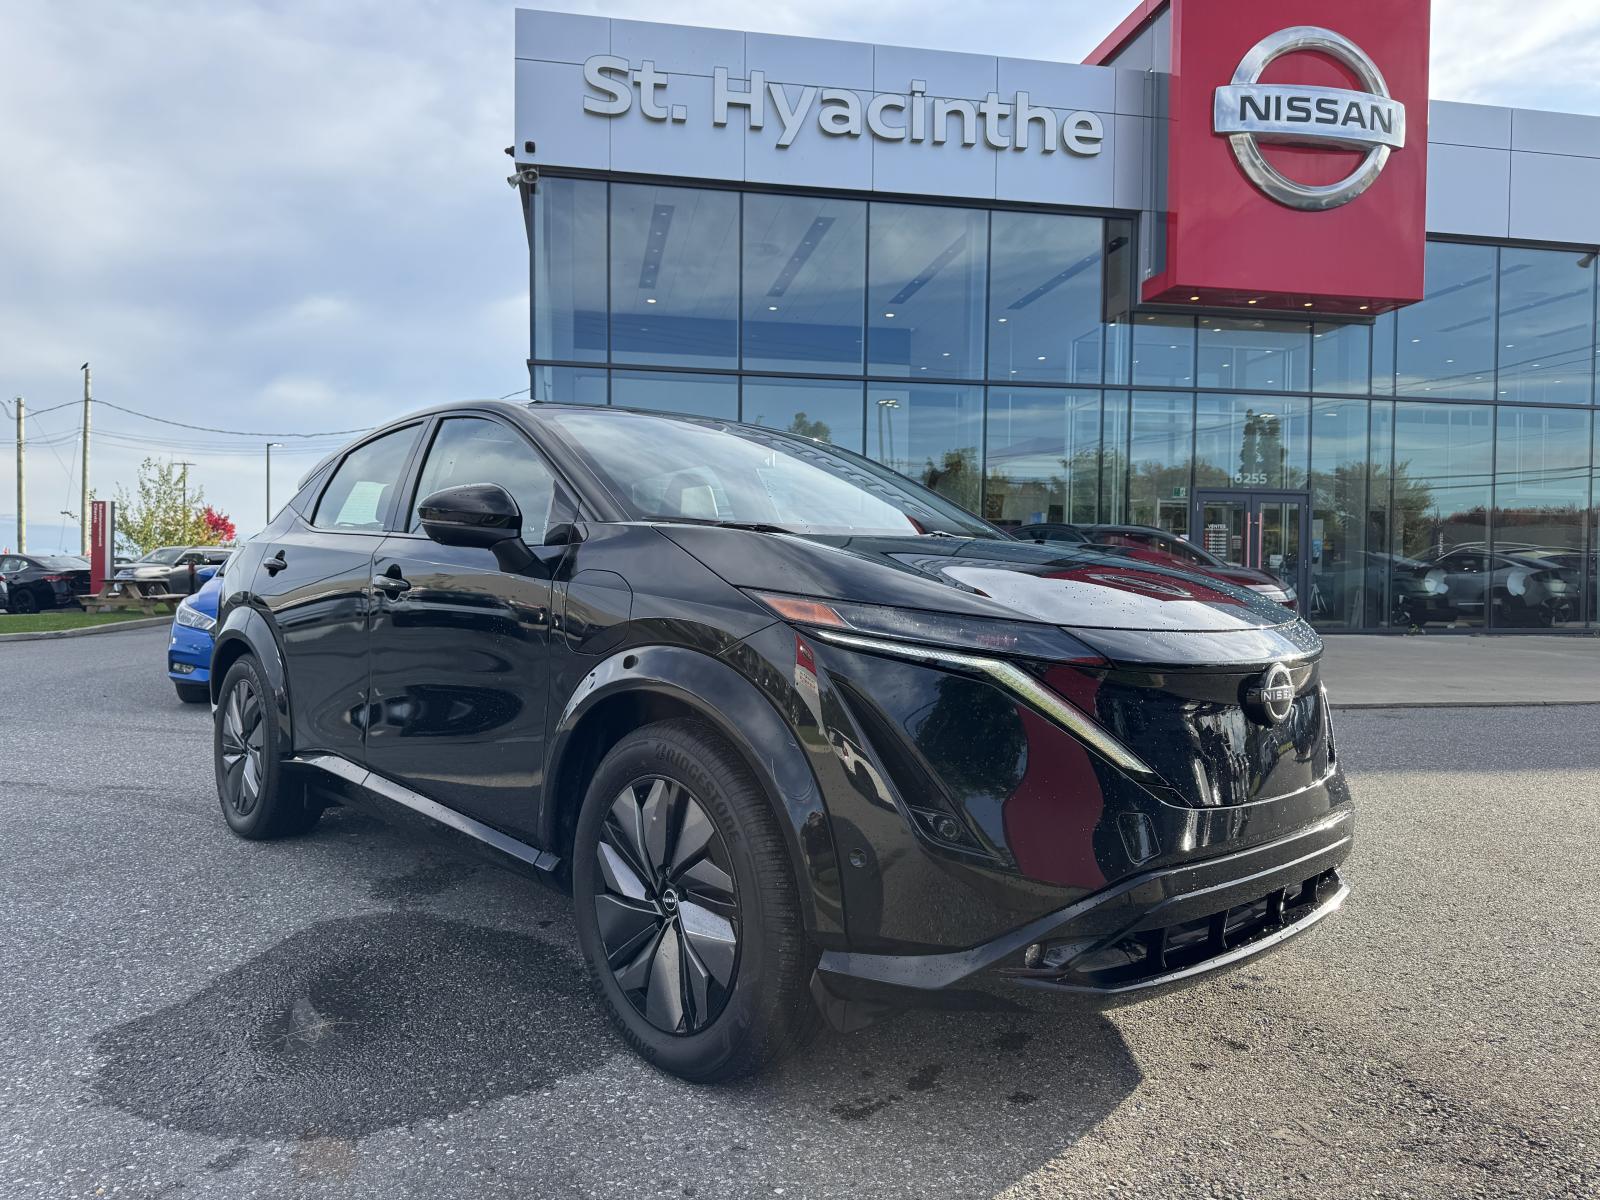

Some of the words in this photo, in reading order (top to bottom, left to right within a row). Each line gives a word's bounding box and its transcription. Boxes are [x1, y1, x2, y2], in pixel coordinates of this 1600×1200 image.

[582, 54, 687, 123] St.
[713, 66, 1104, 155] Hyacinthe
[1239, 95, 1392, 134] NISSAN
[1234, 473, 1268, 485] 6255
[655, 743, 742, 844] BRIDGESTONE
